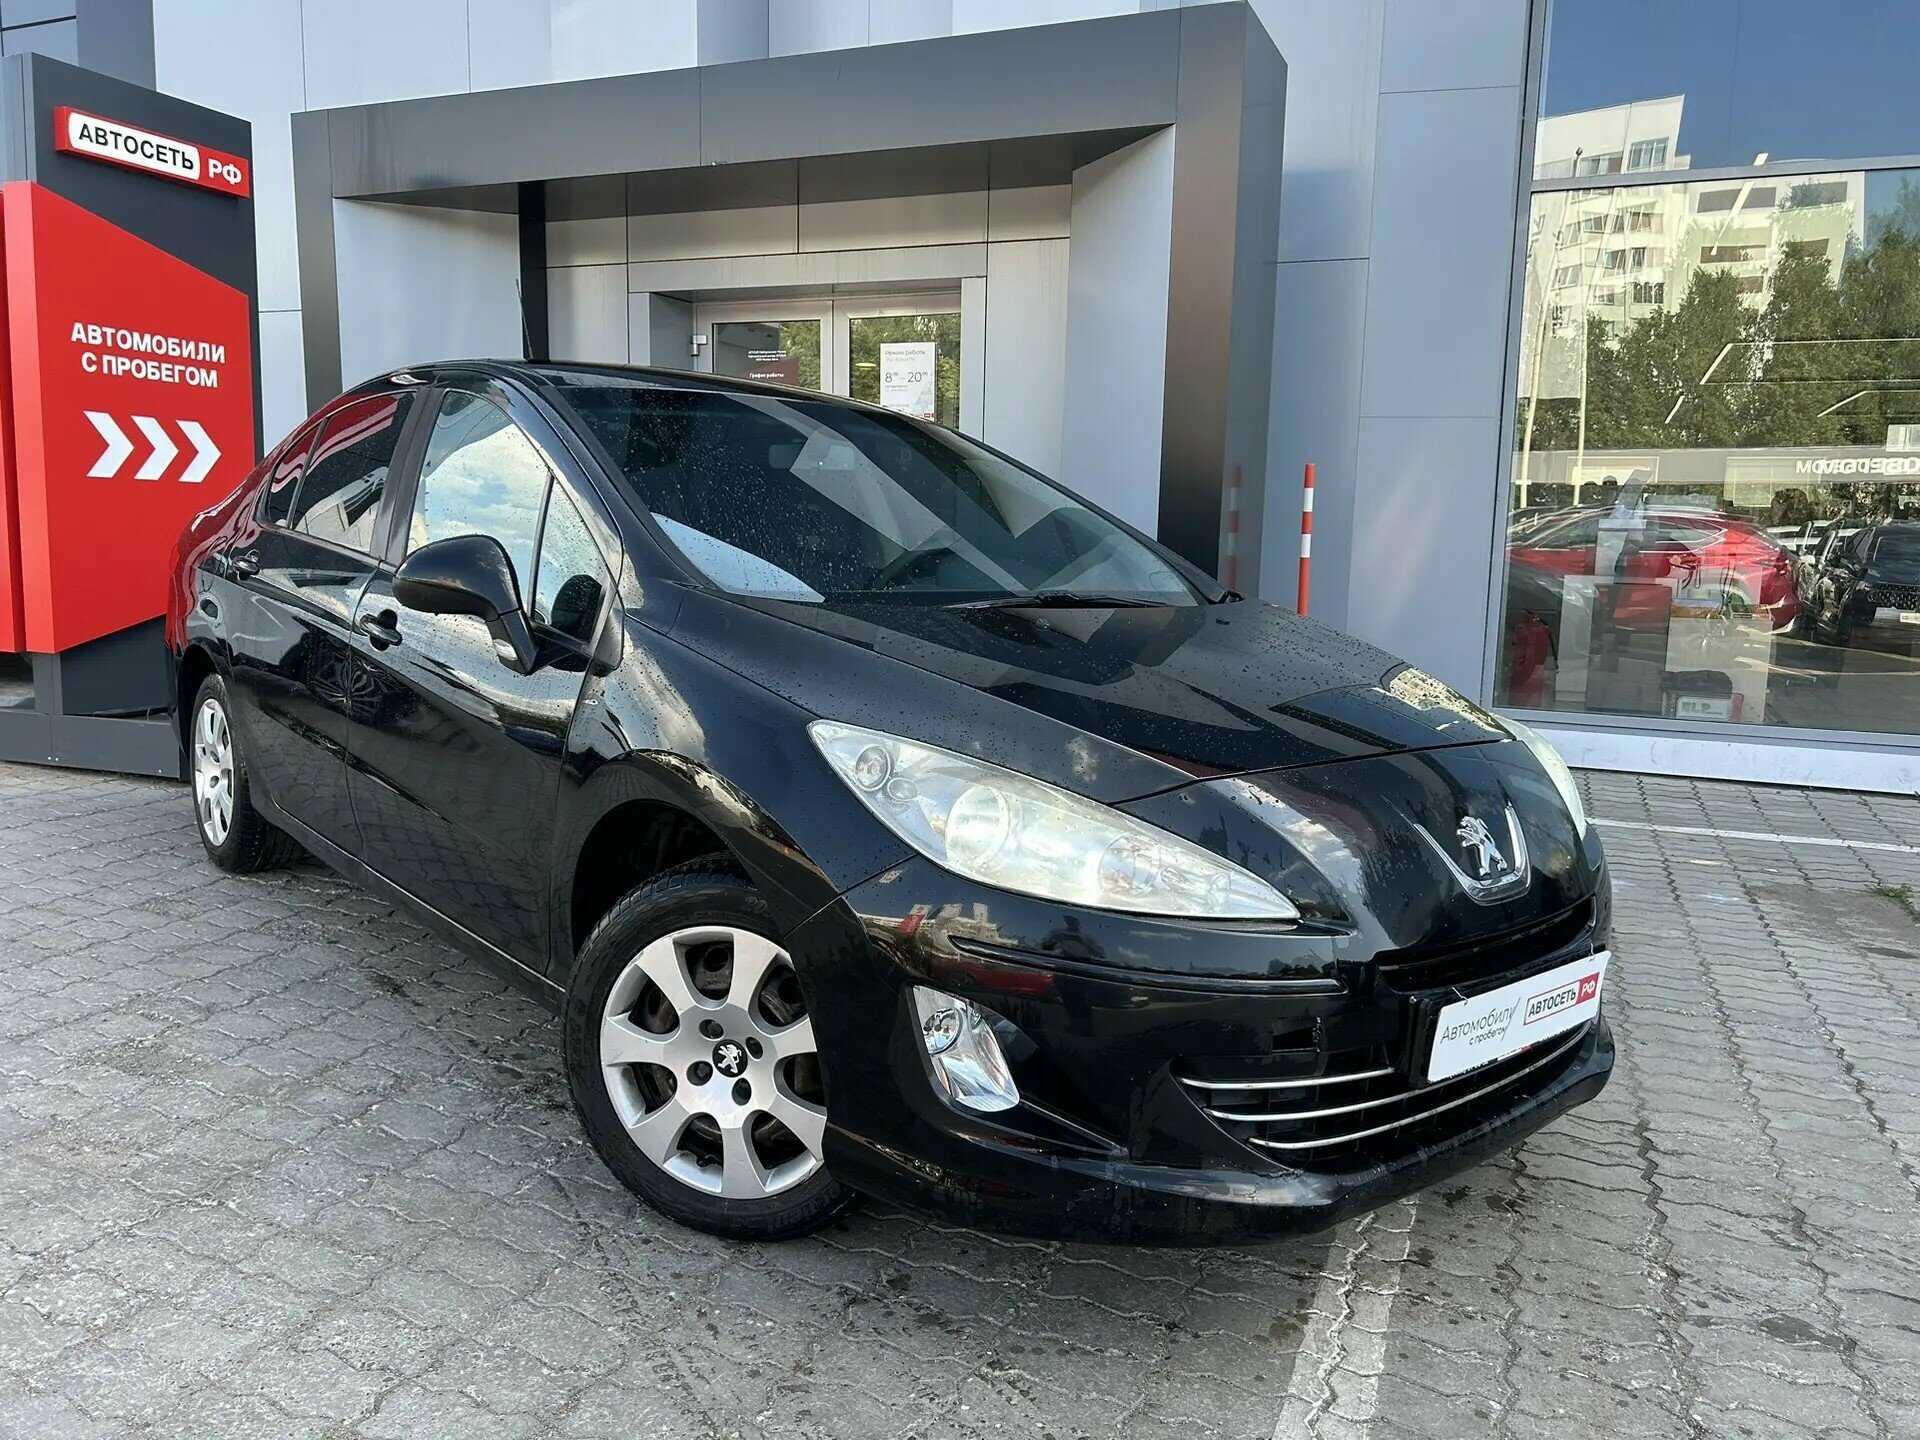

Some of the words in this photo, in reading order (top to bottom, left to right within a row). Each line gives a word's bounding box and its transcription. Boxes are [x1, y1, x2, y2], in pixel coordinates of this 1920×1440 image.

[79, 123, 194, 170] АВТОСЕТЬ
[208, 158, 242, 185] РФ
[71, 323, 225, 364] АВТОМОБИЛИ
[82, 352, 97, 372] С
[103, 357, 218, 387] ПРОБЕГОМ
[1528, 989, 1577, 1017] АВТОСЕТЬ
[1581, 982, 1595, 996] РФ
